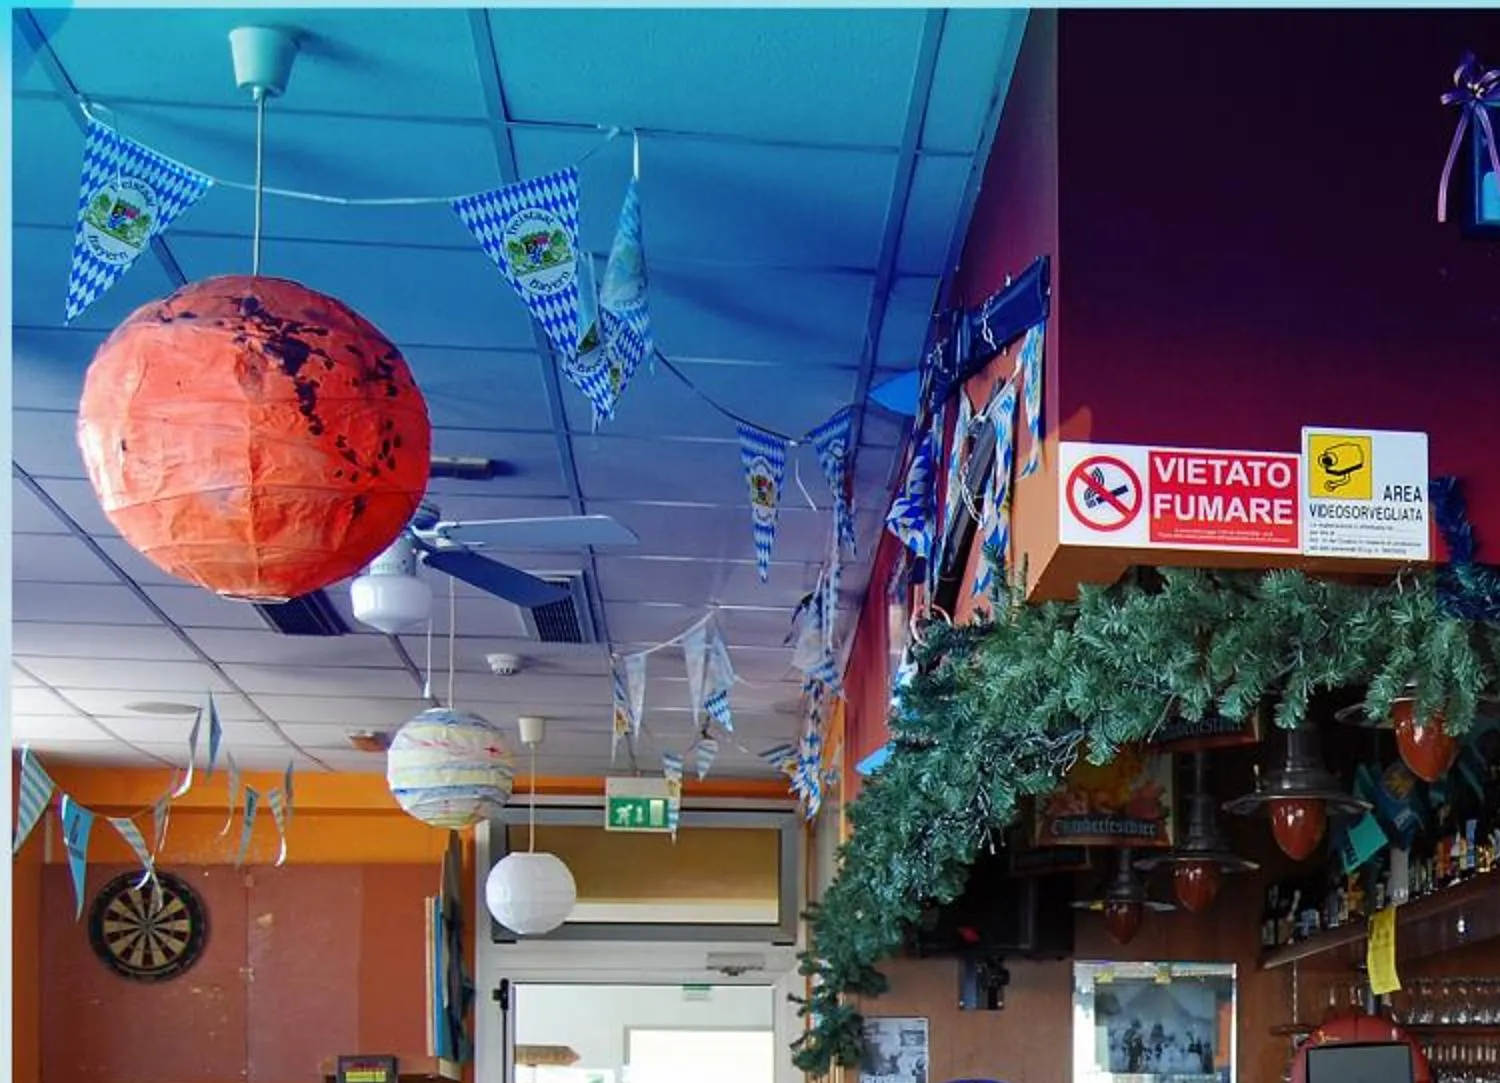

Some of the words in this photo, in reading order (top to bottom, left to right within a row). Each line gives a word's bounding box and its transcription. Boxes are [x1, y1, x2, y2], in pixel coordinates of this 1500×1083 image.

[1153, 456, 1292, 488] VIETATO
[1382, 484, 1424, 504] AREA
[1153, 493, 1294, 526] FUMARE
[1308, 502, 1424, 522] VIDEOSORVEGLIATA
